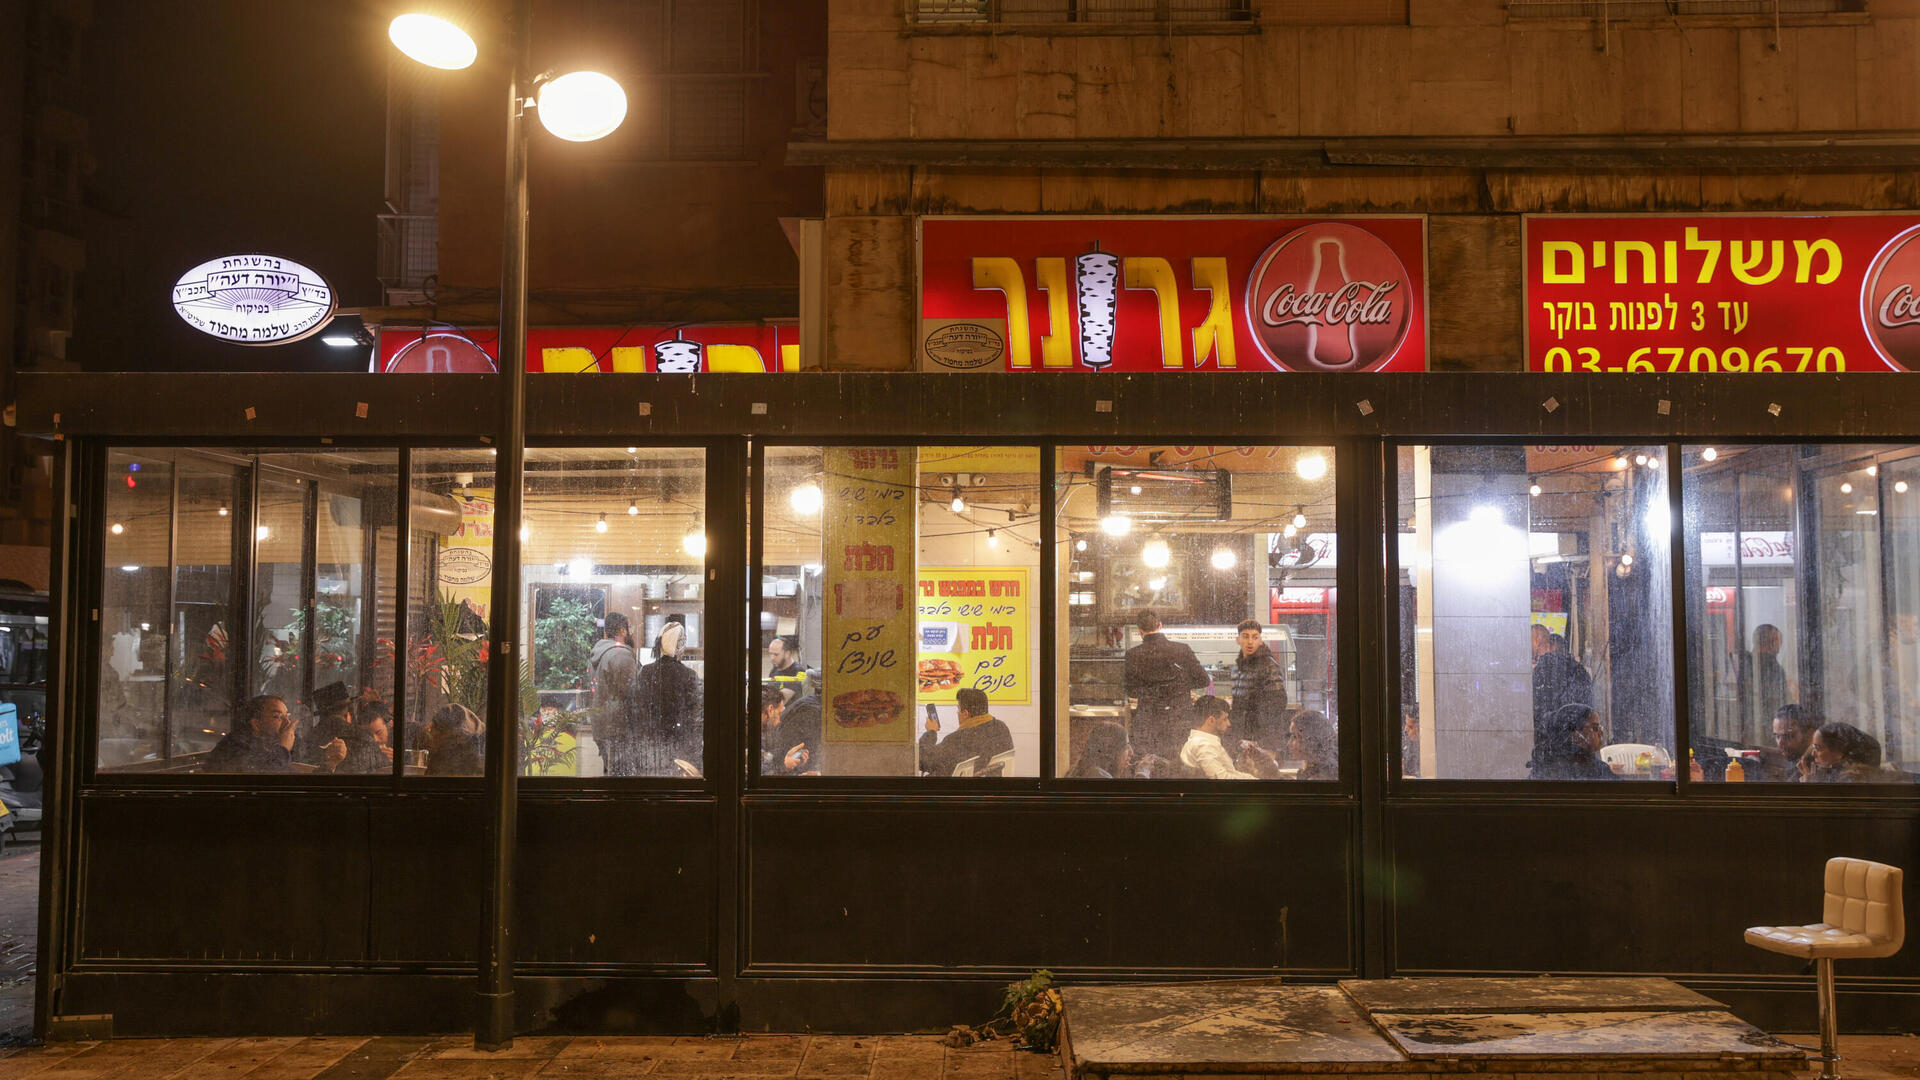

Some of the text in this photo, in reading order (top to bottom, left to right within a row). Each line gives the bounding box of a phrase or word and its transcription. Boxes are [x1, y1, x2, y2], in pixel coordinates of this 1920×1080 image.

[222, 256, 281, 270] בהשגחת
[1542, 226, 1842, 285] משלוחים
[235, 303, 270, 315] בפיקוח
[1262, 281, 1399, 328] Coca-Cola
[1543, 293, 1748, 339] עד 3 לפנות בוקר
[209, 319, 248, 339] מחפוד
[253, 322, 290, 338] שלמה
[843, 540, 895, 571] חלת
[841, 624, 886, 650] עם
[971, 621, 1013, 650] חלת
[973, 655, 1008, 675] עם
